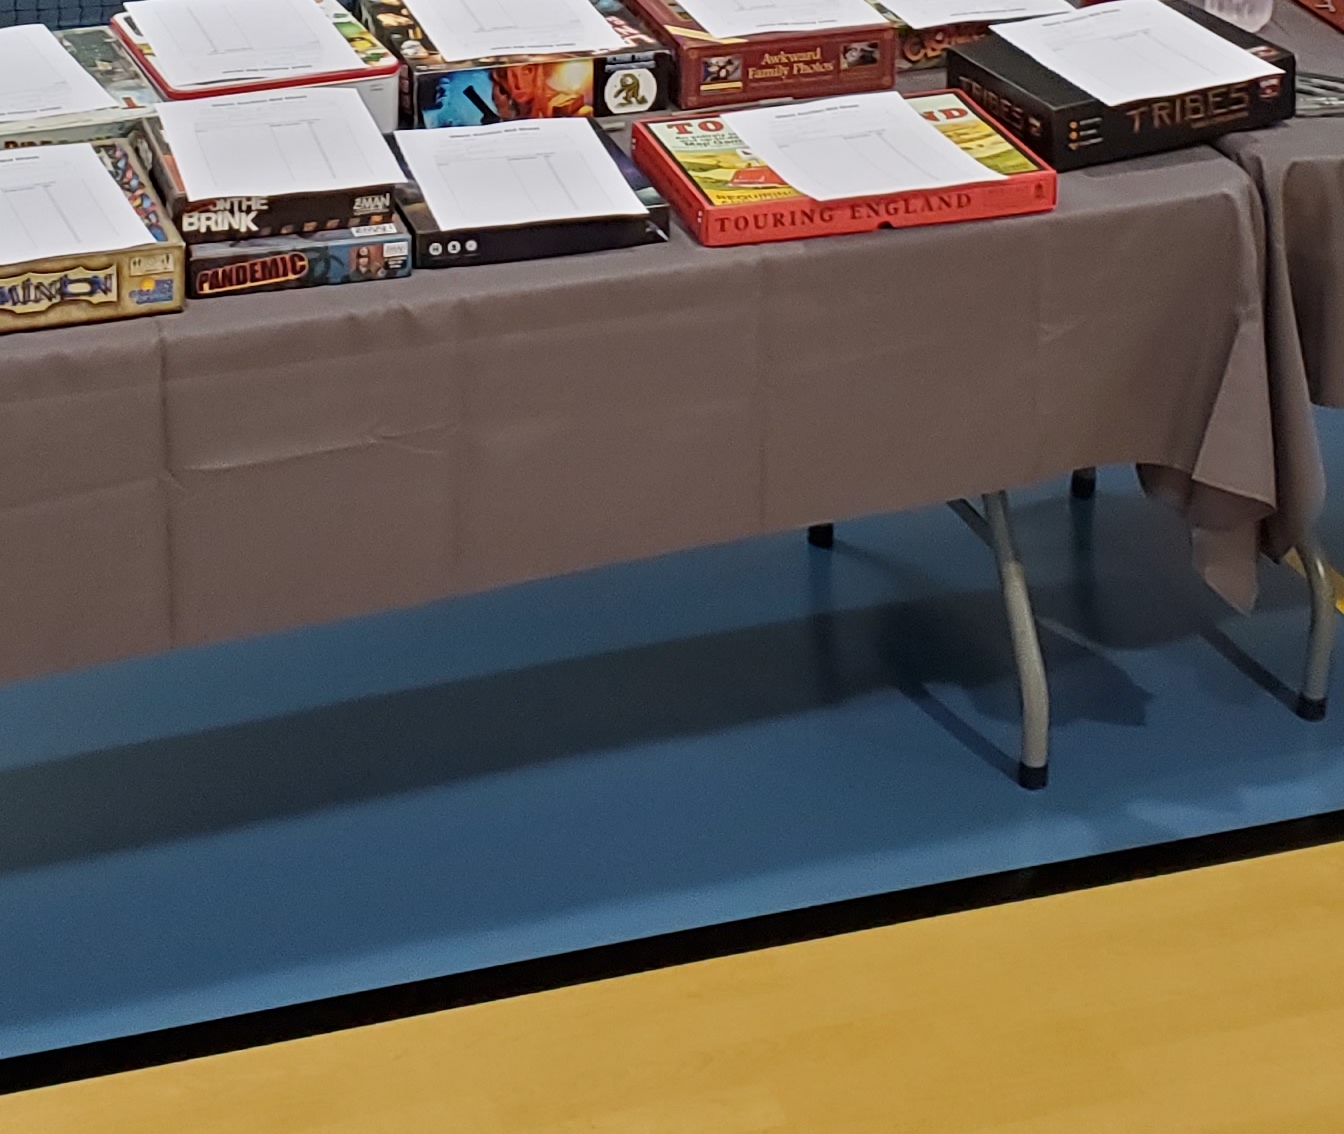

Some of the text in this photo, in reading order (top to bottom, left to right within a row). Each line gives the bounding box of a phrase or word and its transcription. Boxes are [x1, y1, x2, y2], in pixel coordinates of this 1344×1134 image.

[748, 61, 834, 80] Family Photos
[761, 47, 822, 65] Awkward
[1126, 83, 1250, 133] TRIBES
[182, 210, 259, 233] BRINK
[714, 193, 972, 233] TOURING ENGLAND
[197, 252, 308, 294] PANDEMIC
